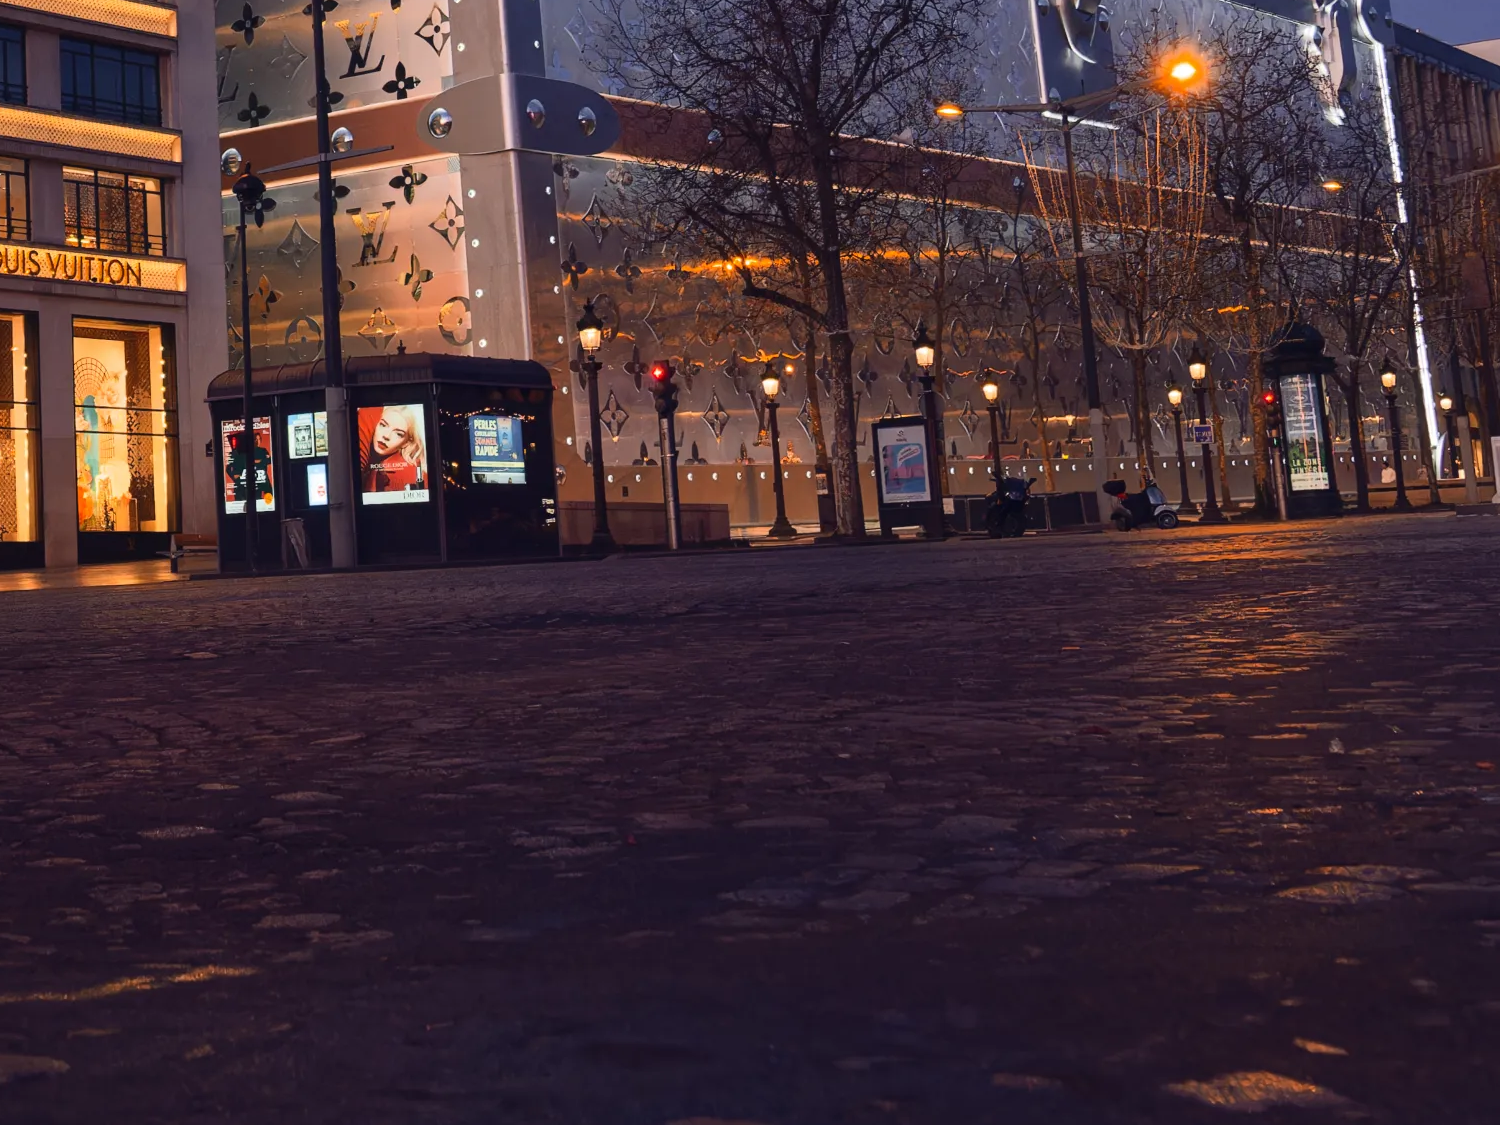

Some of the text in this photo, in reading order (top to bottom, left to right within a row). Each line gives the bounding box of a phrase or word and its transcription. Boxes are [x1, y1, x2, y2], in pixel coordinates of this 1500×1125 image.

[46, 252, 142, 287] VUITTON
[474, 419, 497, 430] PERLES
[475, 445, 499, 456] RAPIDE
[403, 491, 425, 500] DIOR
